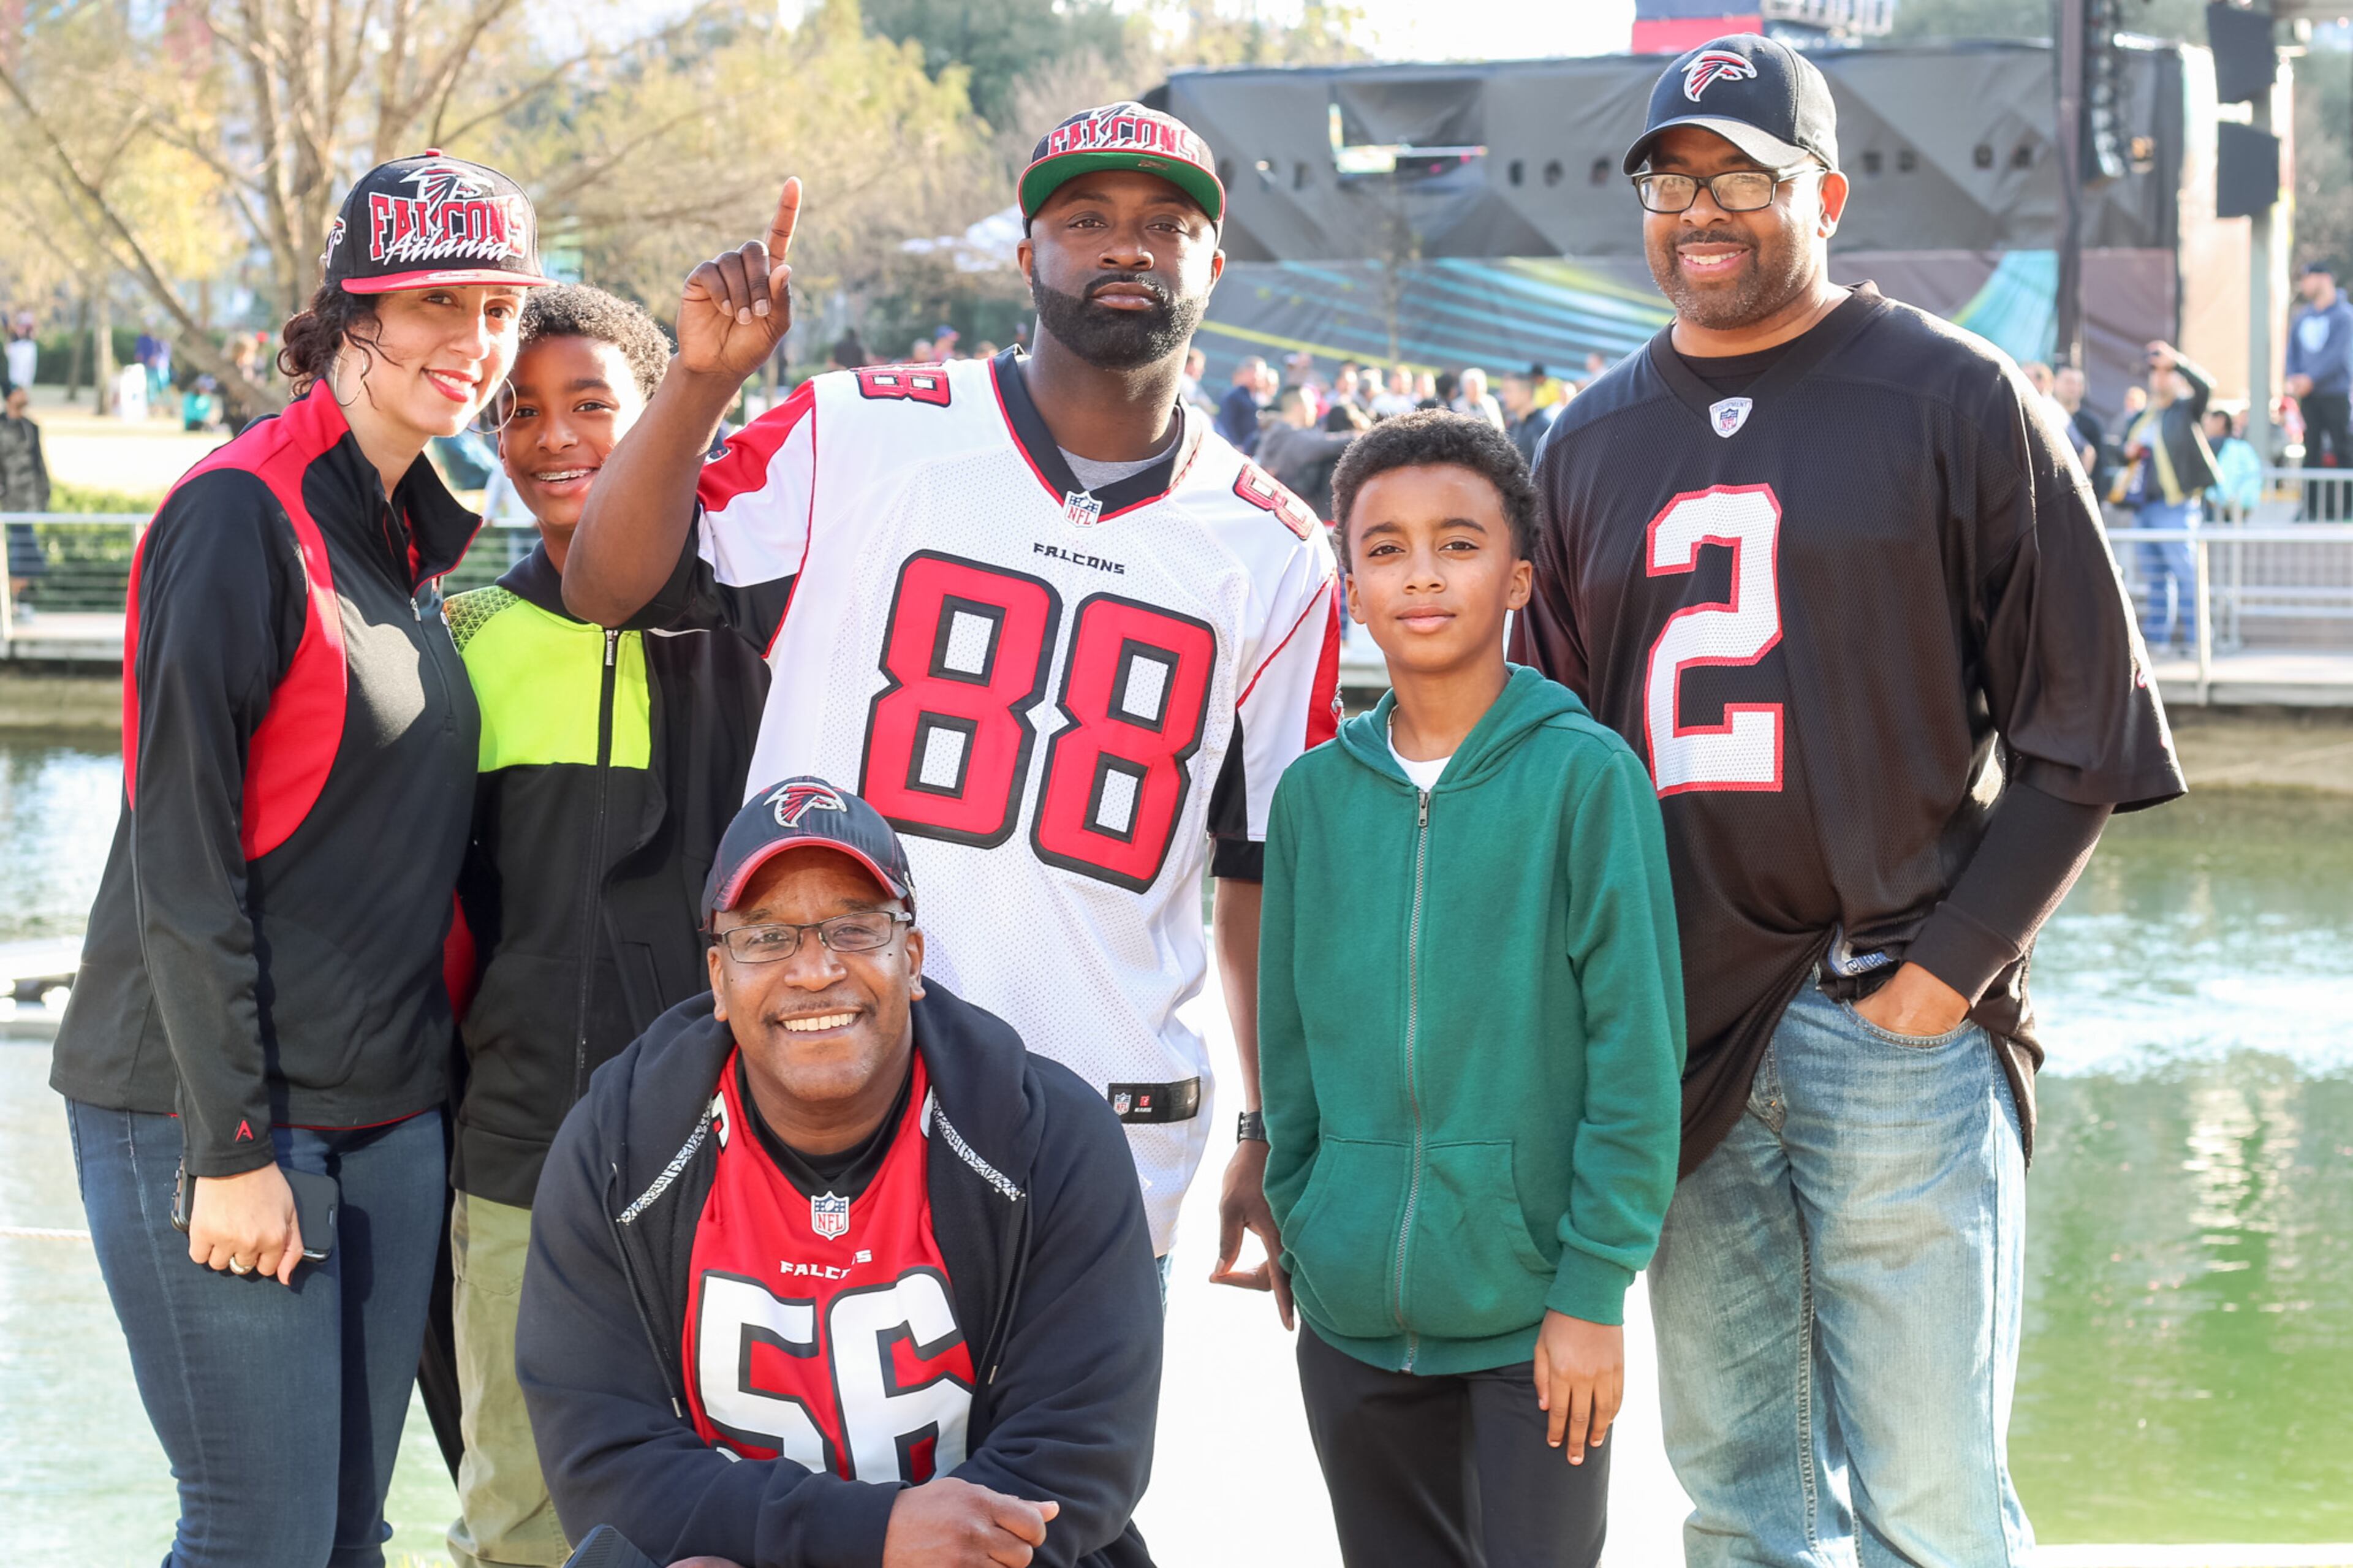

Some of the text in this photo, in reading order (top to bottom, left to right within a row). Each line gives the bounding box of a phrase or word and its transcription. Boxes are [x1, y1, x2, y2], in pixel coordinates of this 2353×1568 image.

[1047, 116, 1200, 164] FALCONS
[369, 192, 527, 262] FALCONS
[384, 228, 512, 266] Atlanta
[1721, 418, 1737, 430] NFL
[1067, 506, 1091, 525] NFL
[1033, 542, 1125, 575] FALCONS
[1643, 482, 1784, 799] 2
[857, 548, 1218, 895] 88
[817, 1213, 843, 1232] NFL
[780, 1249, 873, 1280] FALCS
[695, 1266, 978, 1485] 56
